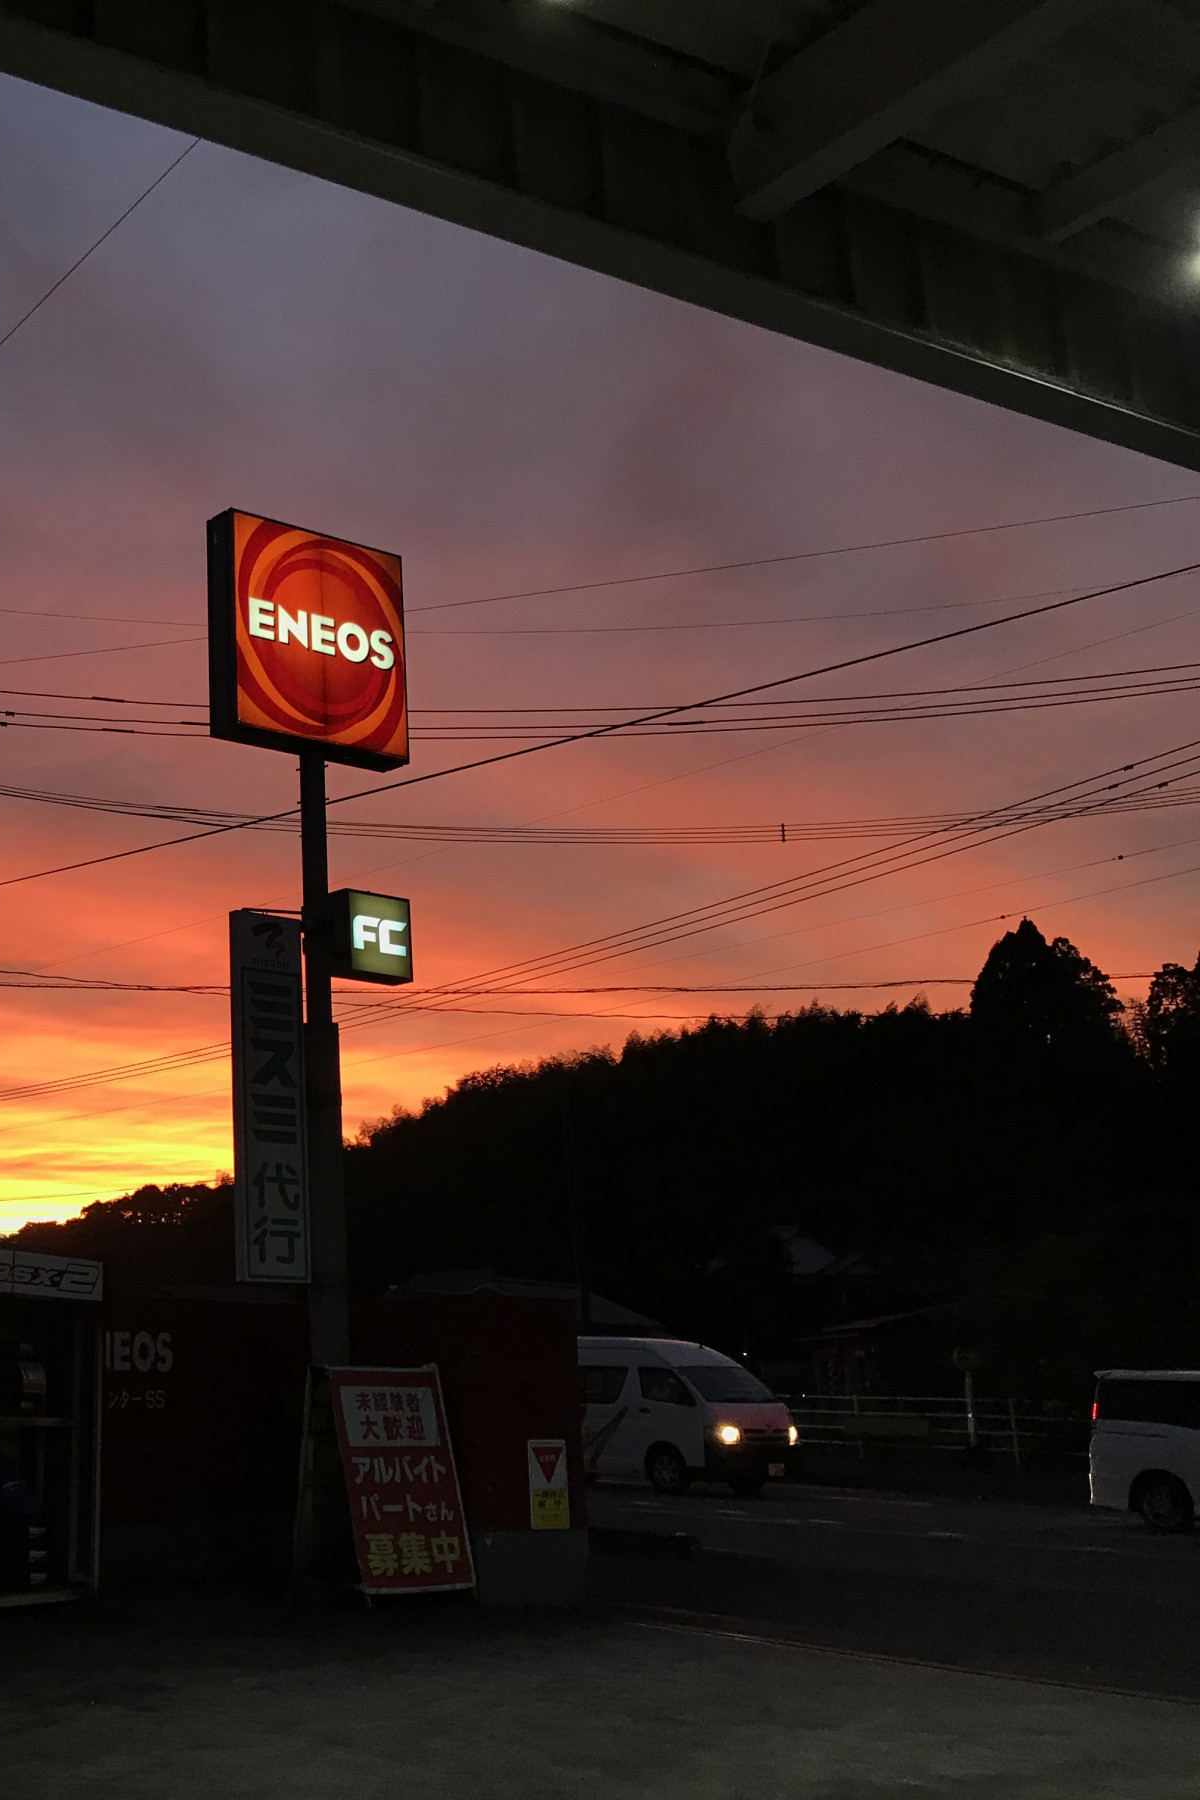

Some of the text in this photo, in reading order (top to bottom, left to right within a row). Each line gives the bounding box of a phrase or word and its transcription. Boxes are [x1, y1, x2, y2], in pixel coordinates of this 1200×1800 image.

[248, 597, 395, 670] ENEOS
[352, 914, 407, 957] FC
[250, 957, 290, 970] misumi
[356, 1392, 420, 1412] 未経験者
[359, 1415, 426, 1441] 大歓迎
[351, 1455, 447, 1484] アルバイト
[361, 1493, 453, 1522] パートさん
[364, 1530, 461, 1577] 募集中
